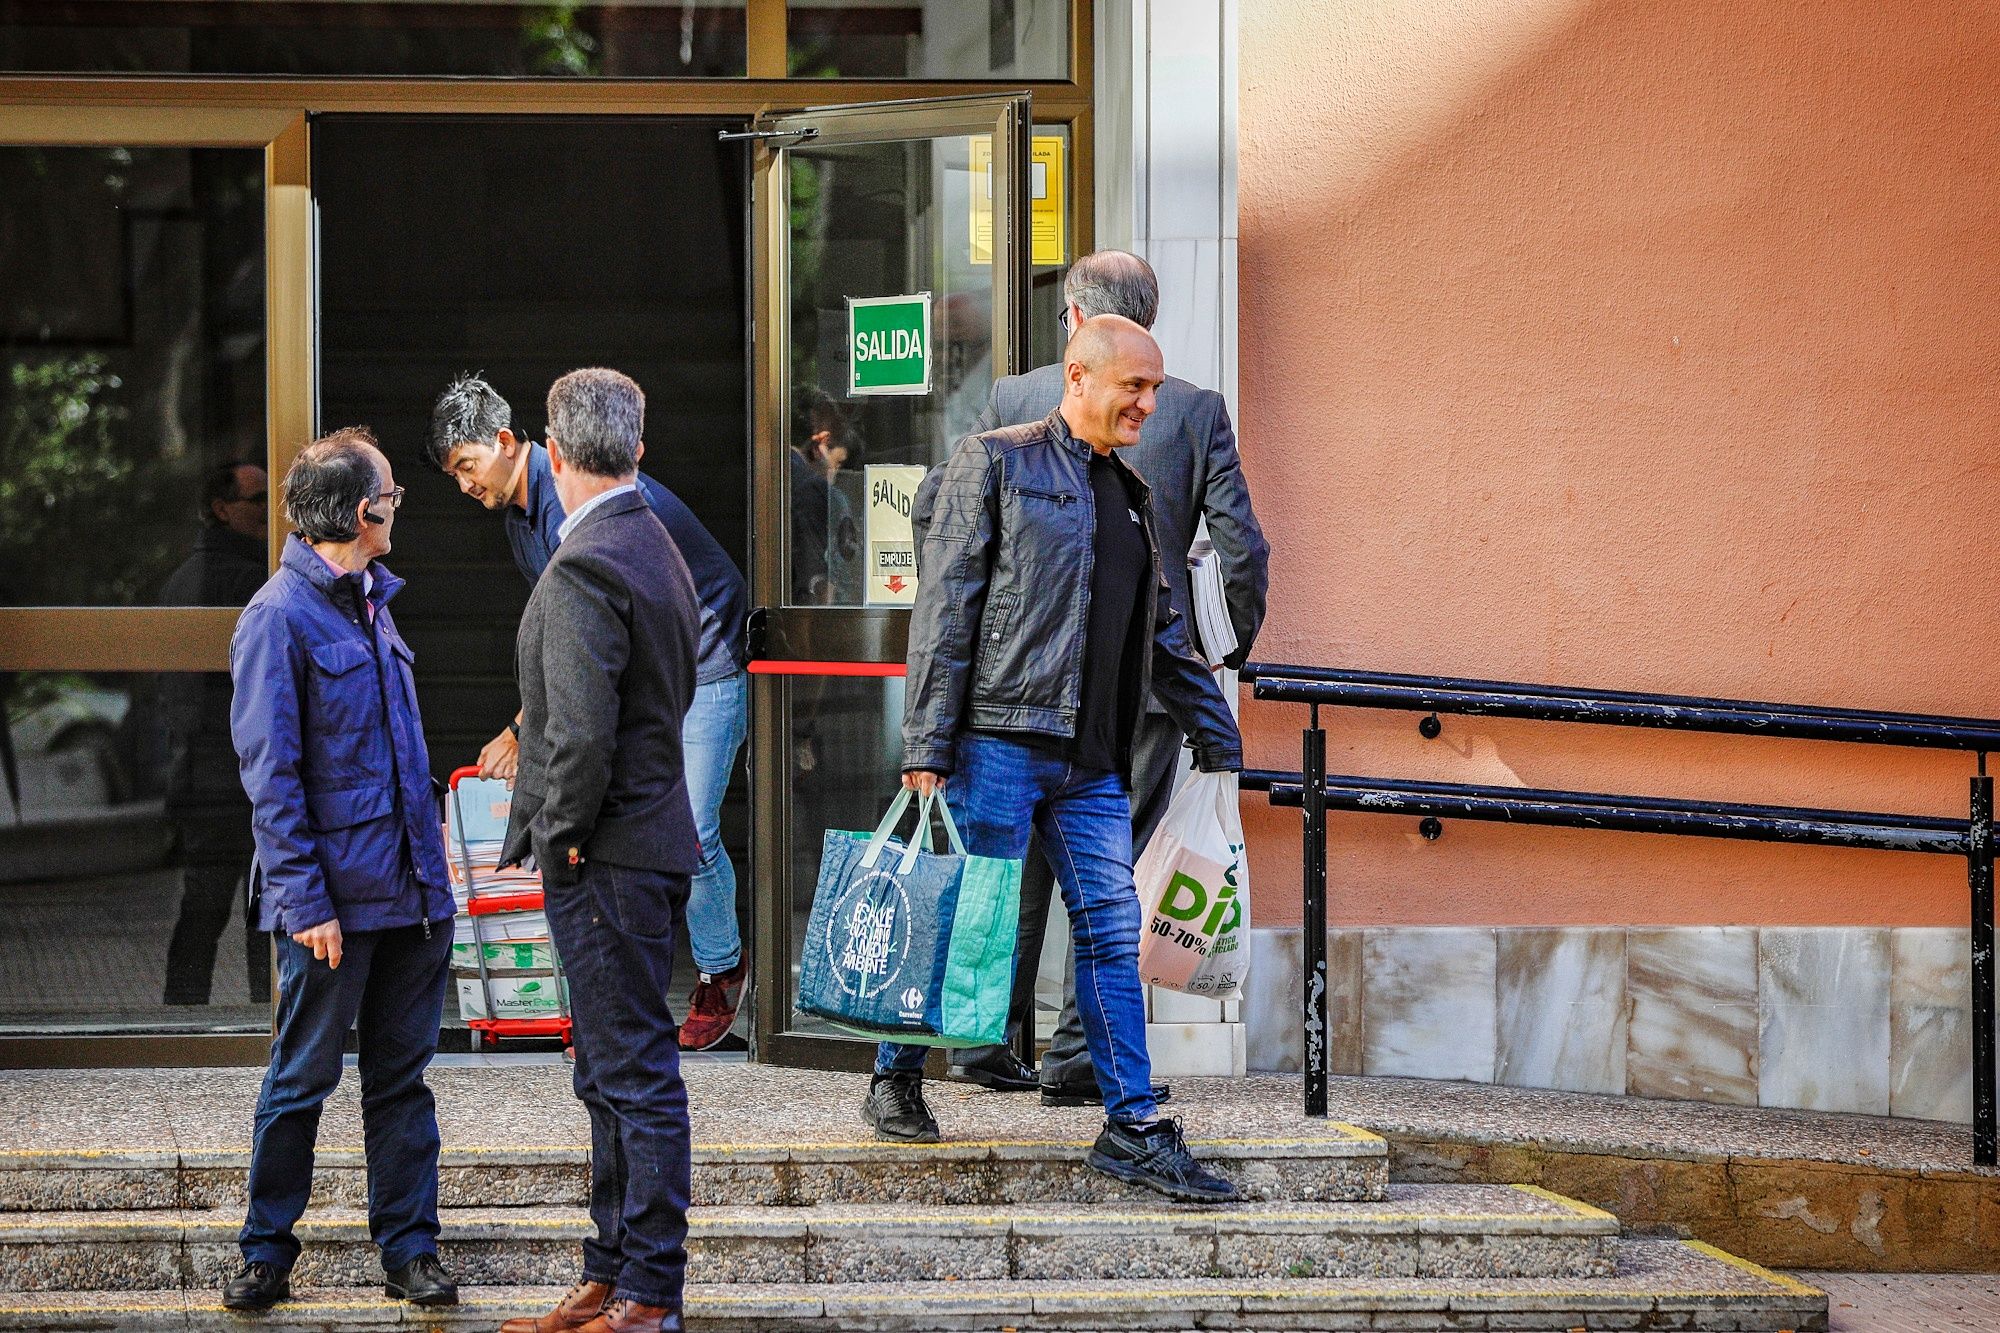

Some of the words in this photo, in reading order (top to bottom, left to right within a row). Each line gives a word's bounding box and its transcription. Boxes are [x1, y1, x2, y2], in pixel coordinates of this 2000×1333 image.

[856, 329, 923, 361] SALIDA
[873, 479, 911, 518] SALID
[880, 552, 912, 565] EMPUJE
[1150, 915, 1207, 956] 50-70%
[496, 998, 558, 1007] MasterPap
